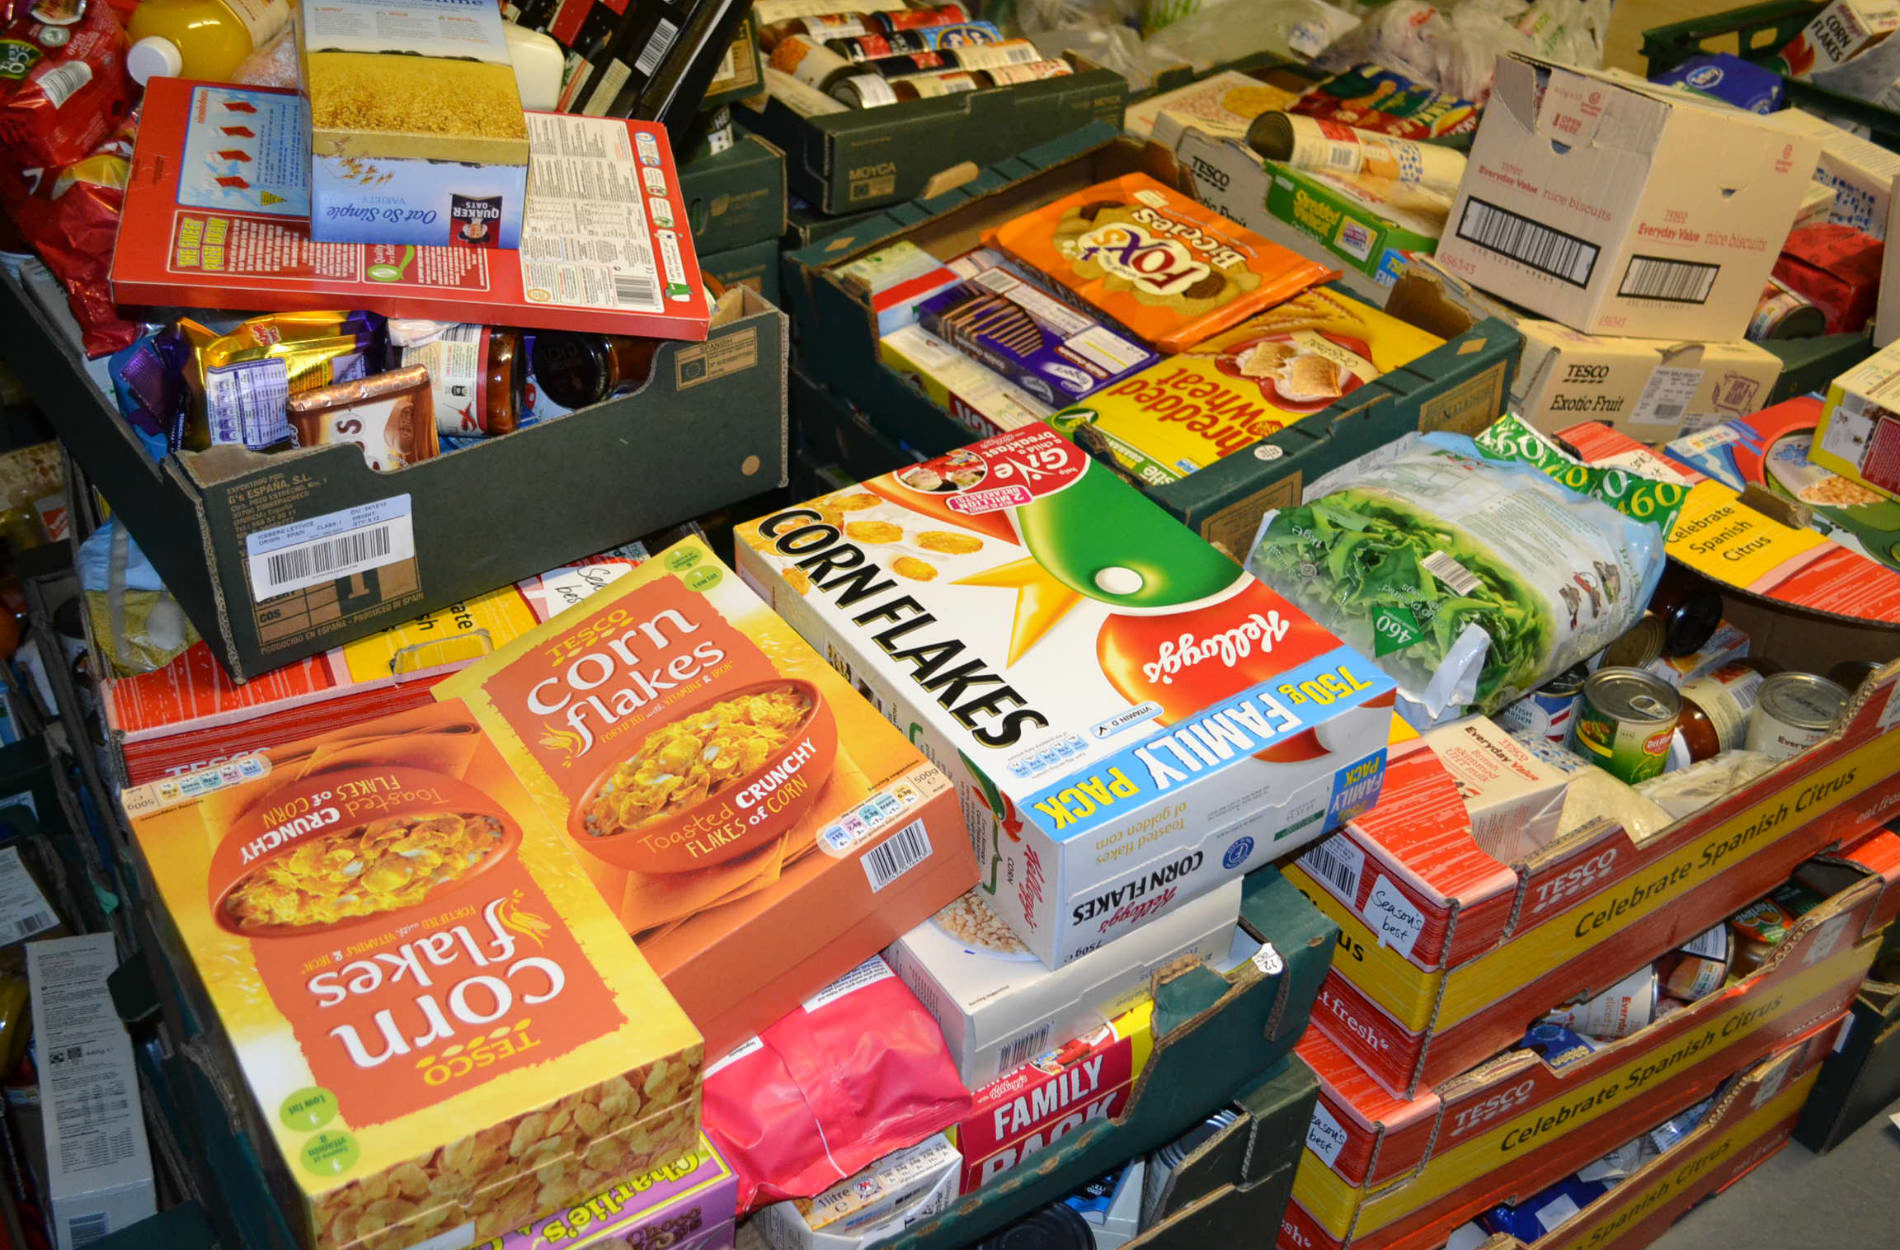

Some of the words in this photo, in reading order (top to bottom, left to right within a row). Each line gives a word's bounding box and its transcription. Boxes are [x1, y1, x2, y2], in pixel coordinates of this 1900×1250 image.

[1812, 20, 1844, 63] FLAKES
[1826, 14, 1852, 48] CORN
[849, 162, 896, 180] MOYCA
[1192, 156, 1230, 187] TESCO
[453, 207, 500, 218] QUAKER
[1478, 164, 1515, 185] Everyday
[1516, 178, 1538, 194] Value
[1568, 195, 1612, 221] biscuits
[327, 206, 376, 222] Simple
[383, 208, 402, 223] So
[406, 210, 437, 224] Oat
[1132, 208, 1248, 270] Biccies
[1638, 222, 1676, 240] Everyday
[1678, 228, 1701, 242] Value
[1729, 235, 1768, 251] biscuits
[1567, 364, 1610, 378] TESCO
[1107, 380, 1254, 458] hredded
[1158, 368, 1265, 430] Wheat
[1550, 395, 1595, 412] Exotic
[1596, 396, 1624, 412] Fruit
[982, 431, 1056, 458] breakfast
[1029, 441, 1053, 453] child
[1666, 503, 1736, 545] Celebrate
[1690, 519, 1752, 554] Spanish
[1723, 532, 1771, 562] Citrus
[259, 608, 282, 624] COS
[545, 608, 629, 659] TESCO
[758, 509, 898, 610] CORN
[851, 594, 1049, 748] FLAKES
[1376, 614, 1412, 644] 460
[528, 609, 700, 715] corn
[1143, 610, 1290, 684] Kellogg's
[566, 641, 724, 759] flakes
[1279, 666, 1372, 706] 750g
[1120, 705, 1153, 724] VITAMIN
[1134, 693, 1303, 790] FAMILY
[1464, 725, 1510, 763] Everyday
[1510, 760, 1540, 782] Value
[1499, 738, 1530, 762] TESCO
[336, 775, 400, 800] FLAKES
[735, 737, 817, 809] CRUNCHY
[913, 768, 940, 784] 500g
[1346, 756, 1380, 786] PACK
[262, 798, 310, 829] CORN
[311, 790, 333, 807] of
[348, 787, 443, 818] Toasted
[1033, 766, 1140, 830] PACK
[1174, 801, 1187, 817] of
[1330, 772, 1385, 815] FAMILY
[240, 807, 341, 866] CRUNCHY
[637, 803, 735, 854] Toasted
[685, 818, 747, 858] FLAKES
[748, 805, 768, 826] of
[766, 774, 810, 814] CORN
[1126, 805, 1172, 838] golden
[1139, 816, 1186, 850] Toasted
[1095, 830, 1124, 850] corn
[1095, 835, 1135, 866] flakes
[1573, 860, 1692, 938] Celebrate
[1697, 807, 1788, 870] Spanish
[1794, 766, 1857, 813] Citrus
[1018, 844, 1046, 930] Kellogg's
[1151, 850, 1204, 890] CORN
[1534, 848, 1617, 901] TESCO
[1072, 876, 1146, 926] FLAKES
[1098, 886, 1177, 934] Kellogg's
[1372, 890, 1424, 932] Season's
[1382, 916, 1410, 942] best
[306, 895, 517, 1008] flakes
[329, 956, 566, 1069] corn
[1331, 998, 1379, 1050] fresh
[423, 1032, 542, 1087] TESCO
[1500, 1081, 1620, 1152] Celebrate
[1624, 1031, 1714, 1091] Spanish
[1720, 996, 1784, 1038] Citrus
[993, 1054, 1104, 1142] FAMILY
[1451, 1079, 1536, 1128] TESCO
[1308, 1129, 1334, 1155] best
[543, 1154, 700, 1248] Charlie's
[1592, 1181, 1670, 1248] Spanish
[1676, 1138, 1731, 1185] Citrus
